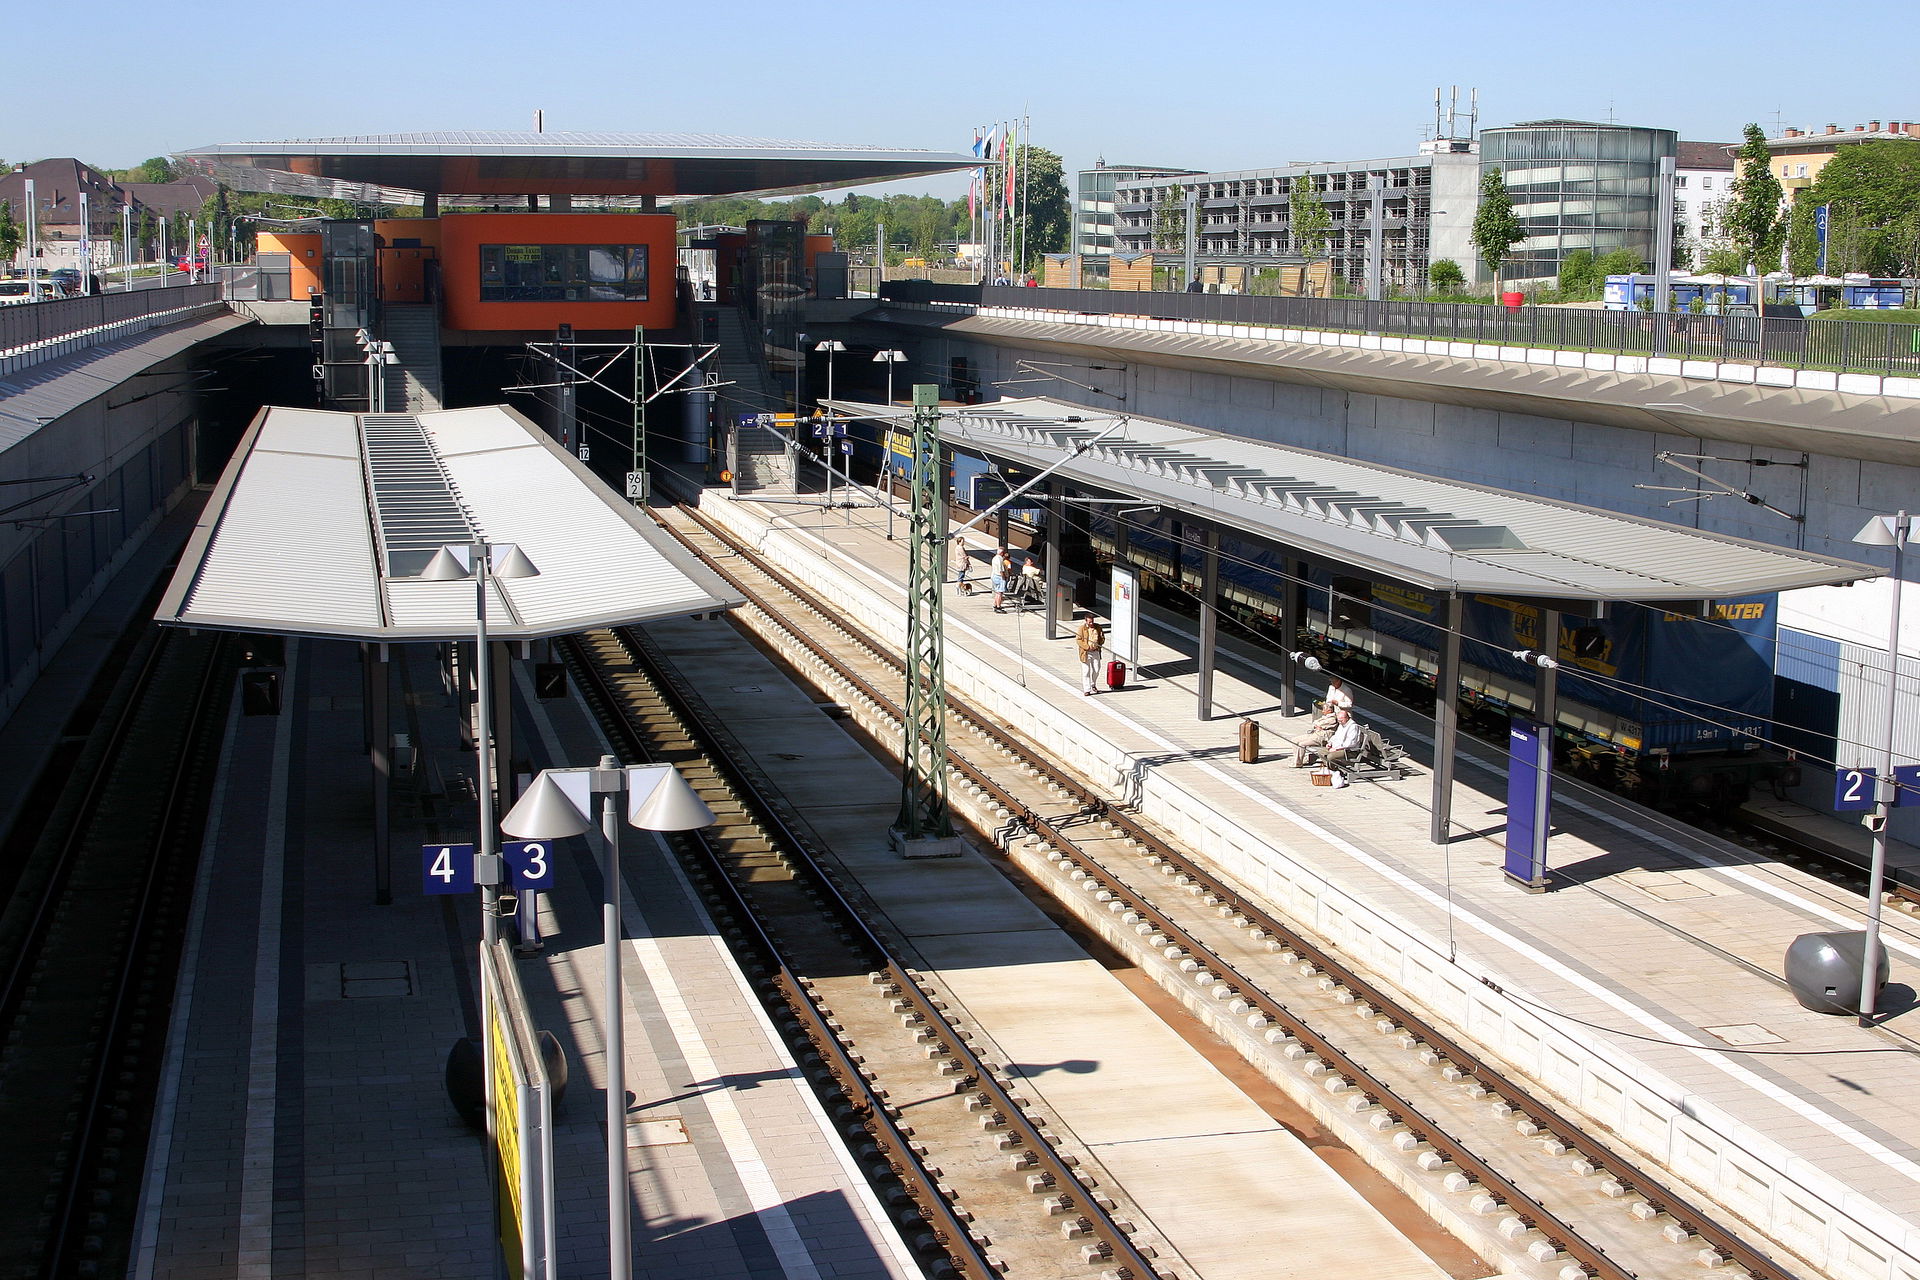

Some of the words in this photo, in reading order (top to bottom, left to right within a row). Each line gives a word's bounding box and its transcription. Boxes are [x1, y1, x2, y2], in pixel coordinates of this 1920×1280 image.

[814, 424, 822, 435] 2
[842, 425, 847, 435] 1
[580, 448, 589, 460] 12
[628, 474, 641, 484] 96
[632, 485, 638, 494] 2
[1843, 770, 1863, 802] 2
[430, 847, 455, 883] 4
[522, 843, 547, 879] 3
